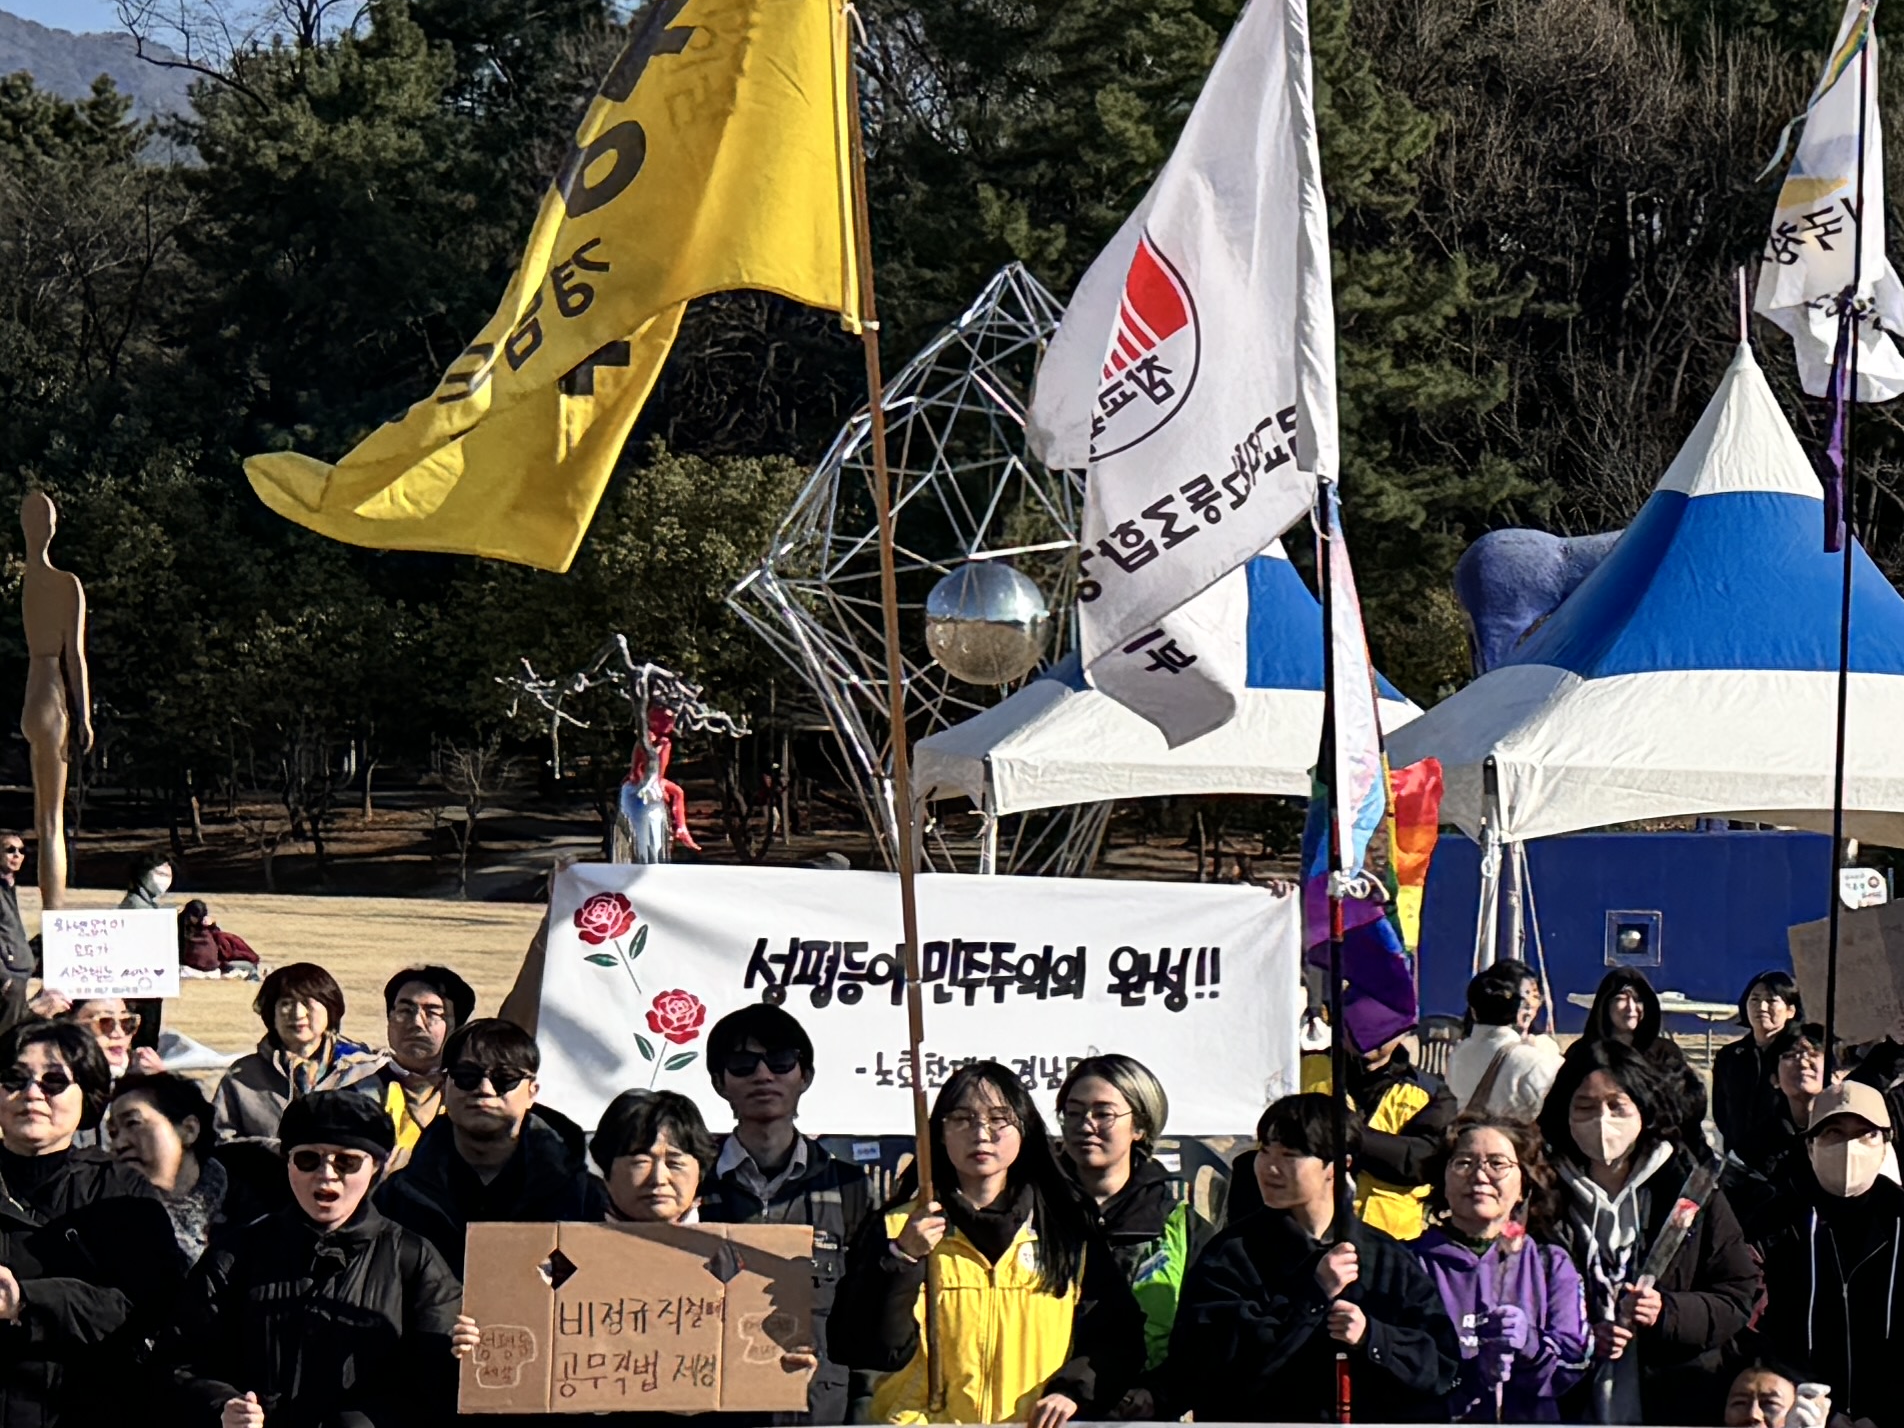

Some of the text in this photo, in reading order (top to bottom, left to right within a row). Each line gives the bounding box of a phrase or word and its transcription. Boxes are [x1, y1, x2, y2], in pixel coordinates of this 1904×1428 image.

[744, 937, 1220, 1012] 성평등이 민주주의의 완성!!
[556, 1349, 659, 1398] 공무직법
